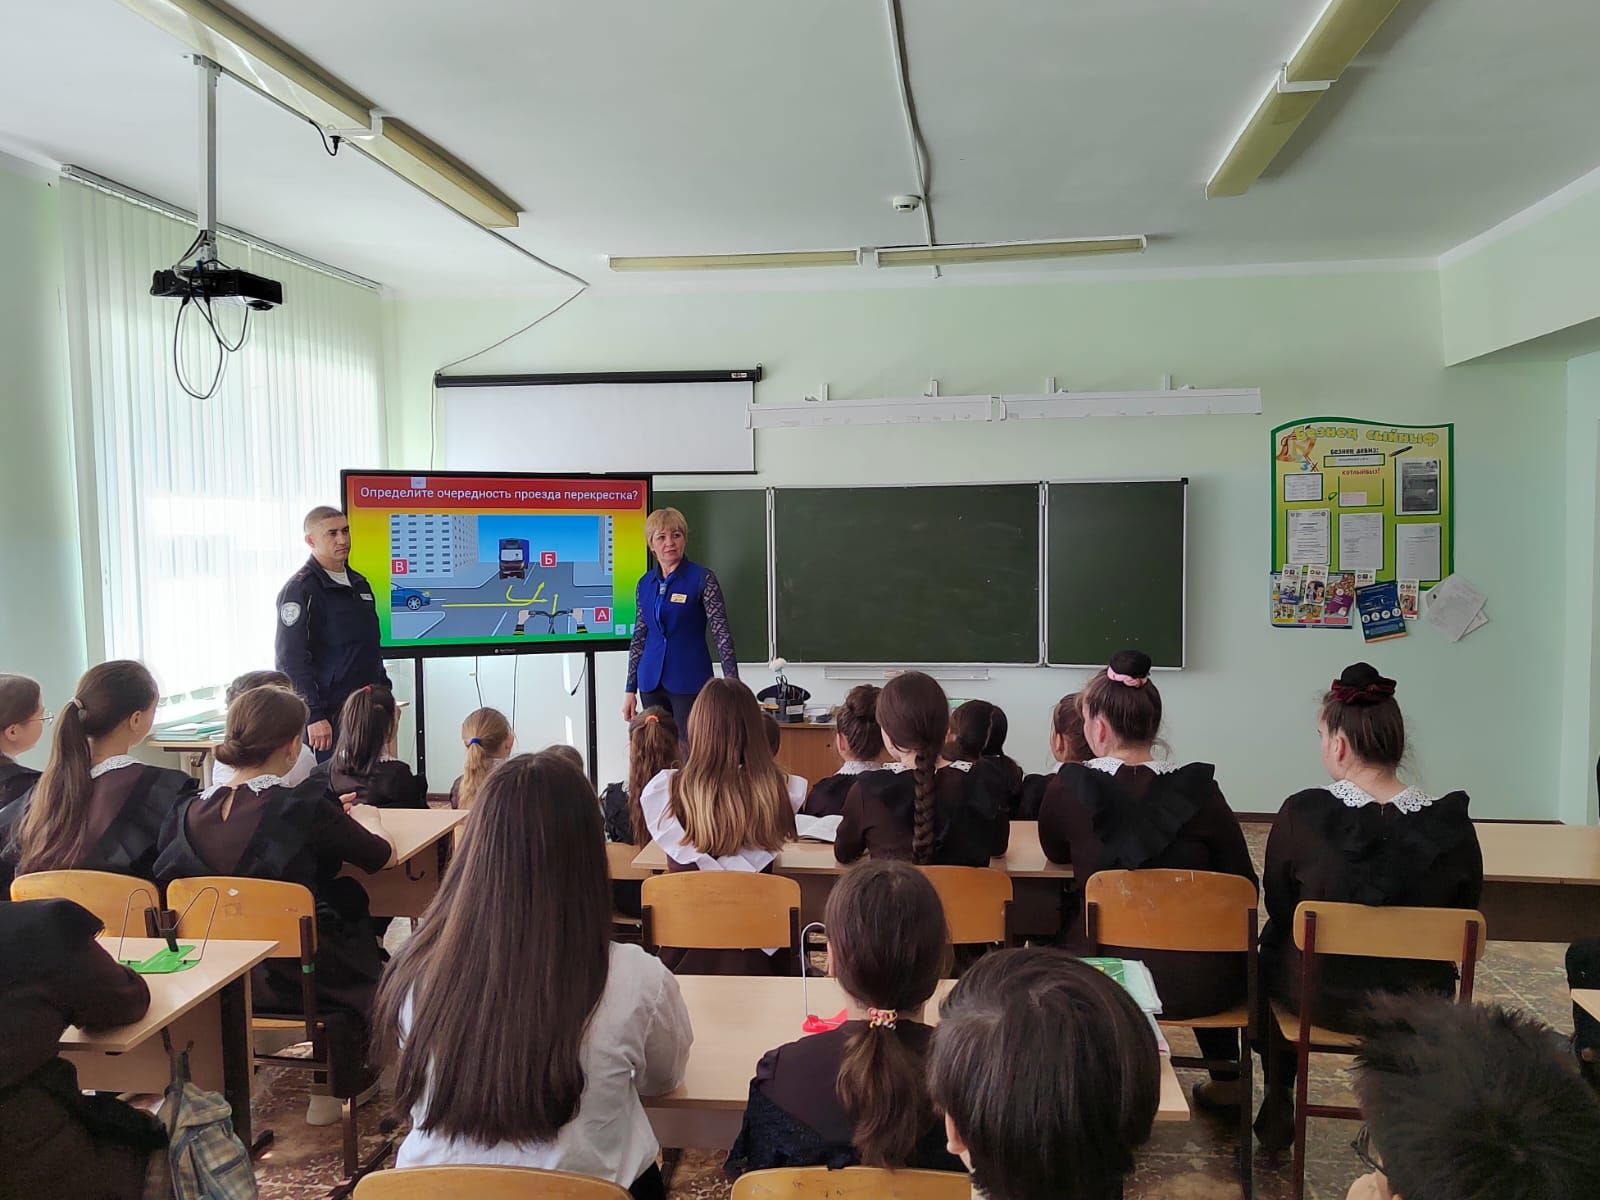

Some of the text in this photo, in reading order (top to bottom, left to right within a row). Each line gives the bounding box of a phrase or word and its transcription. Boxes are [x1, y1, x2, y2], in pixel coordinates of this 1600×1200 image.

[360, 487, 638, 502] Определите очередность проезда перекрестка?
[545, 553, 553, 565] Б
[395, 561, 404, 573] В
[597, 609, 608, 621] А
